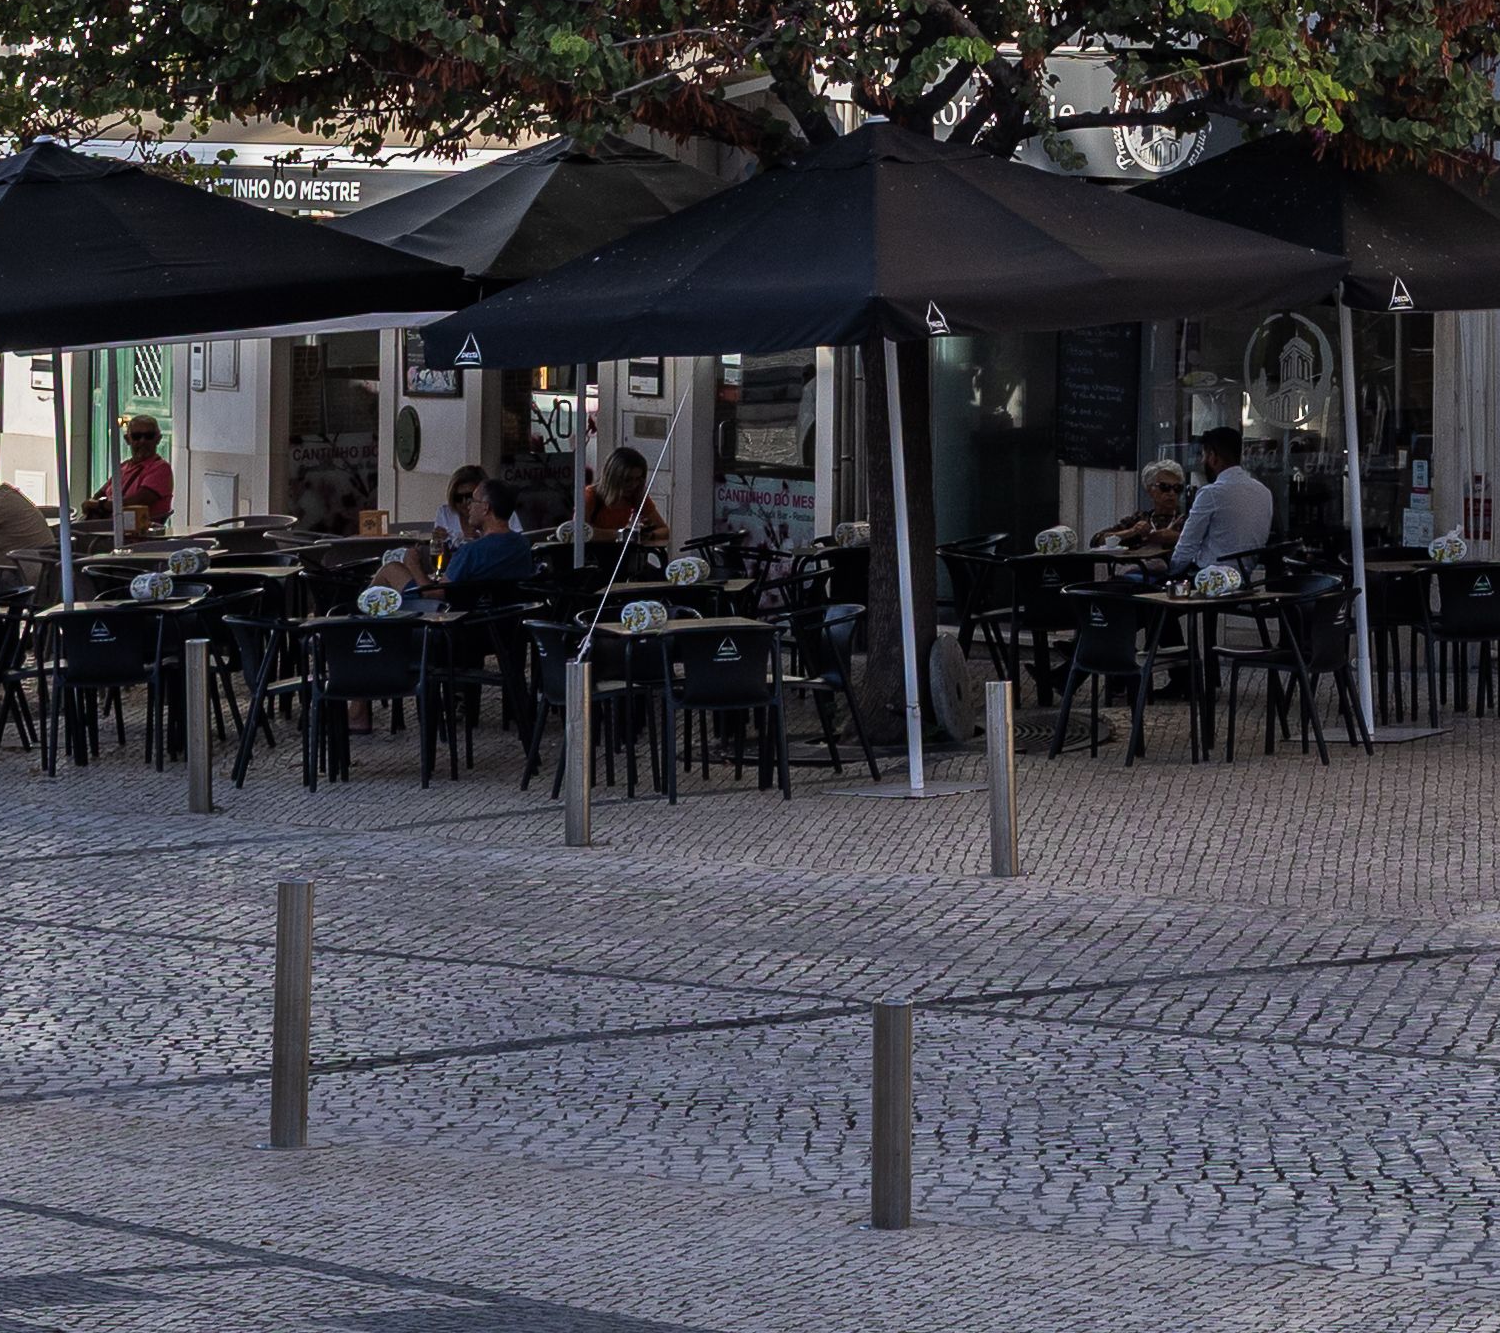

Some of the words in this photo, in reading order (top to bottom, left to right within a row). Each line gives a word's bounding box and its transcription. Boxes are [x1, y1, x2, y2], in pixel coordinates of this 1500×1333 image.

[273, 180, 296, 200] DO
[300, 181, 361, 201] MESTRE
[293, 446, 358, 461] CANTINHO
[718, 488, 771, 505] CANTINHO
[774, 492, 790, 507] DO
